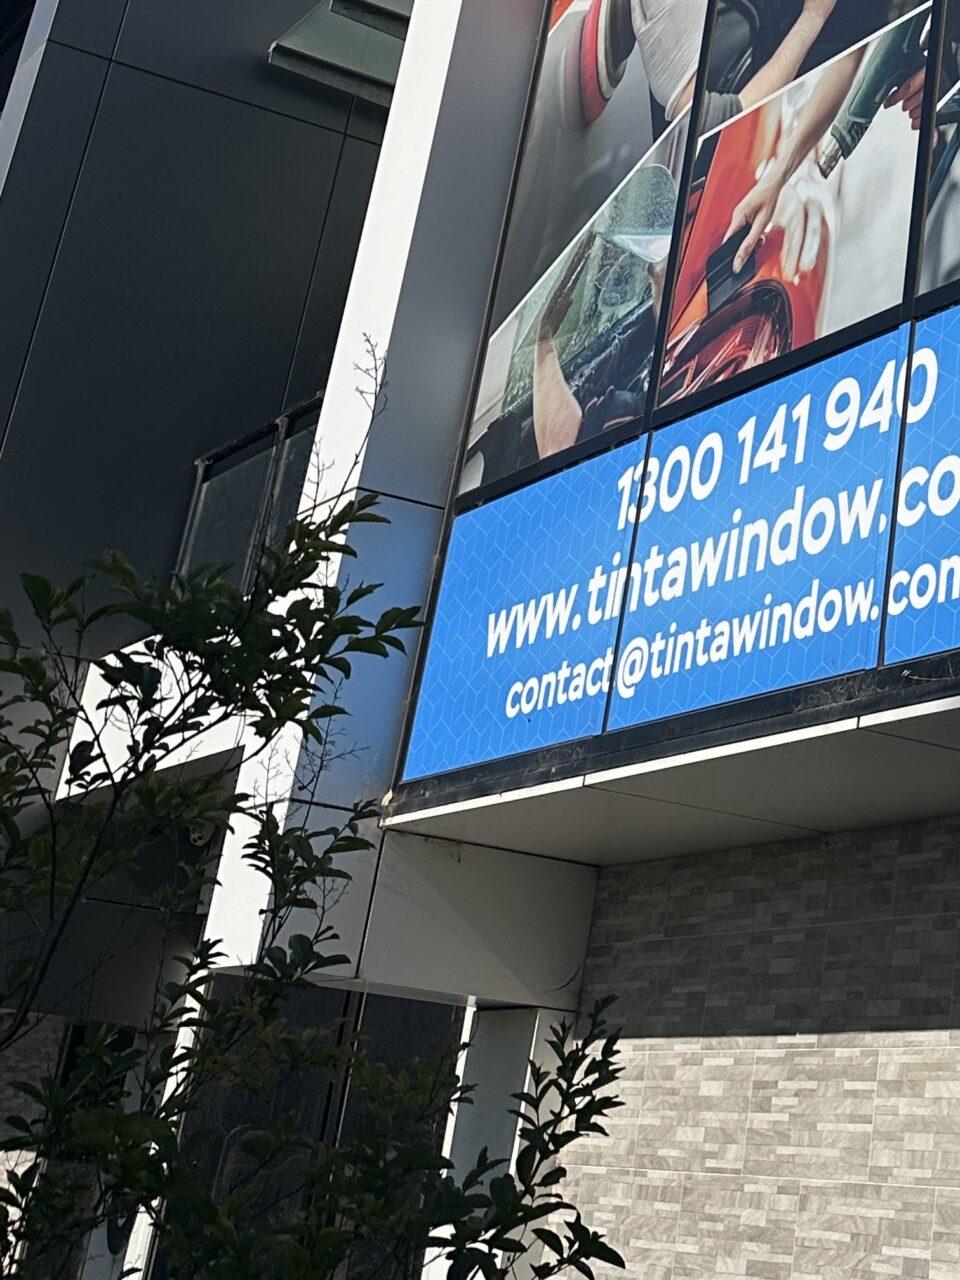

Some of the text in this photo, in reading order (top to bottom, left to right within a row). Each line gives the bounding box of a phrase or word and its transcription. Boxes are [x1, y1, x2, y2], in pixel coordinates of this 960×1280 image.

[617, 347, 938, 531] 1300 141 940
